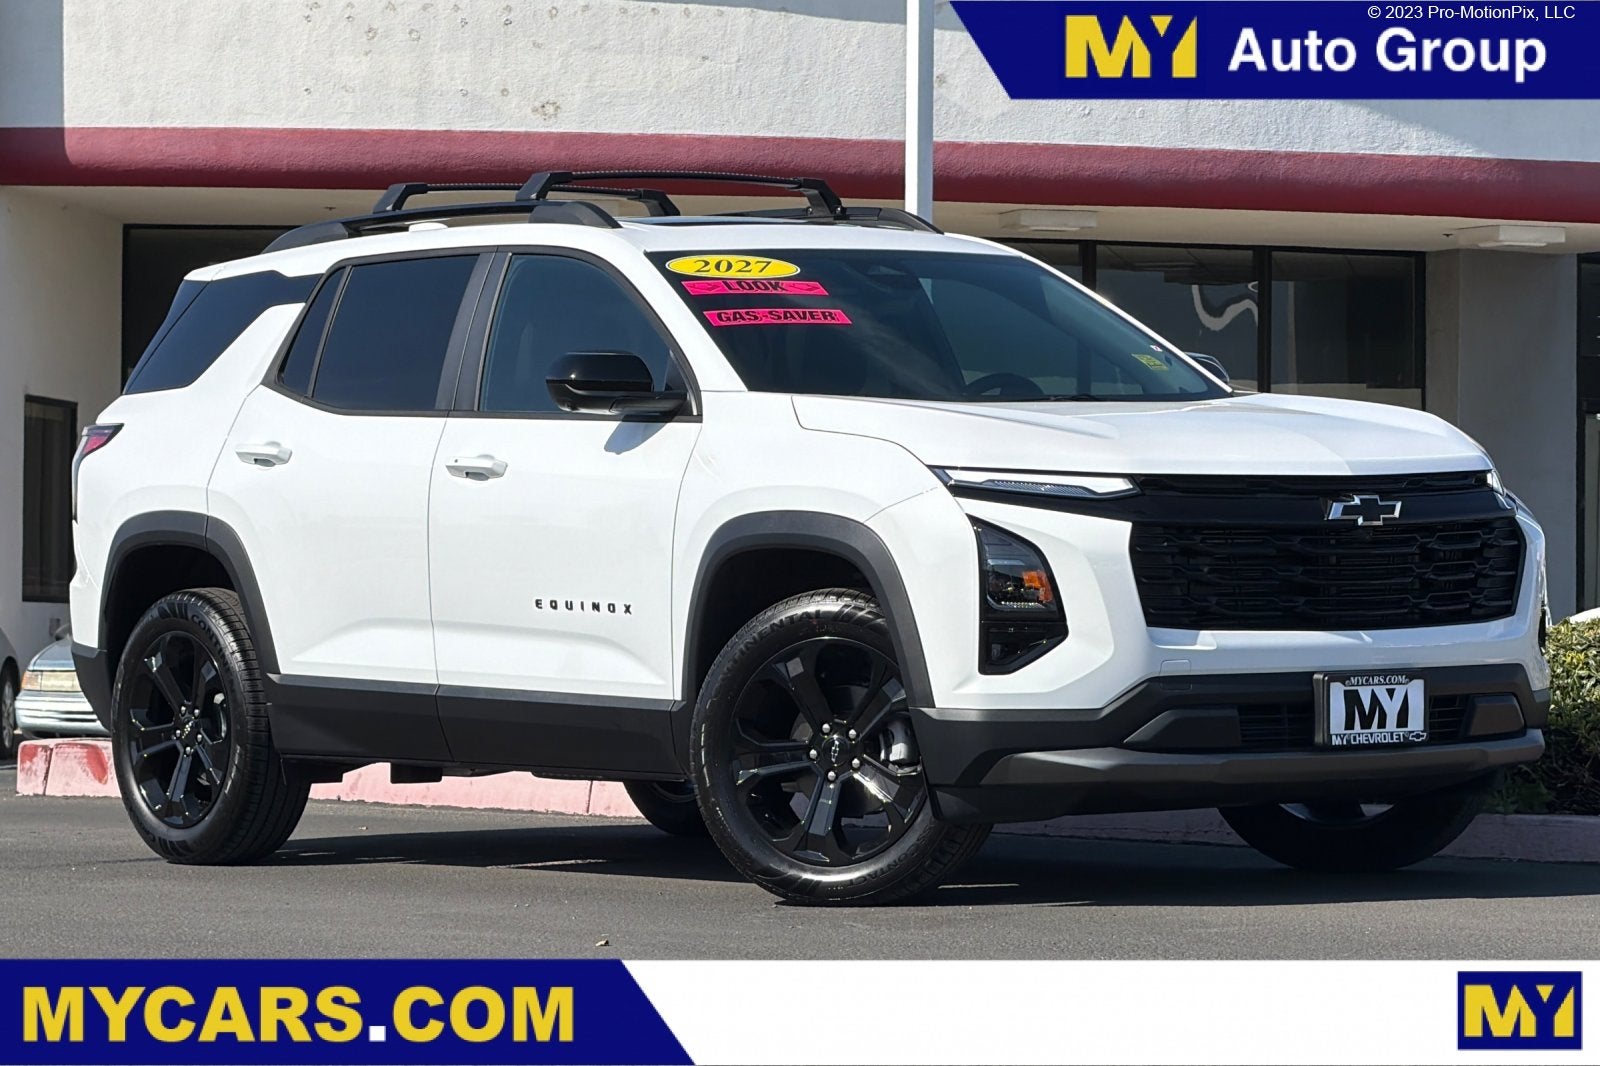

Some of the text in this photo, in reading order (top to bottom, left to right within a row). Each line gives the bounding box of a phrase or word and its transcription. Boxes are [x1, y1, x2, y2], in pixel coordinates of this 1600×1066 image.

[694, 259, 772, 273] 2027
[721, 280, 788, 292] LOOK
[535, 599, 632, 615] EQUINOX
[1350, 675, 1406, 686] MYCARS.COM
[1343, 687, 1409, 731] MY
